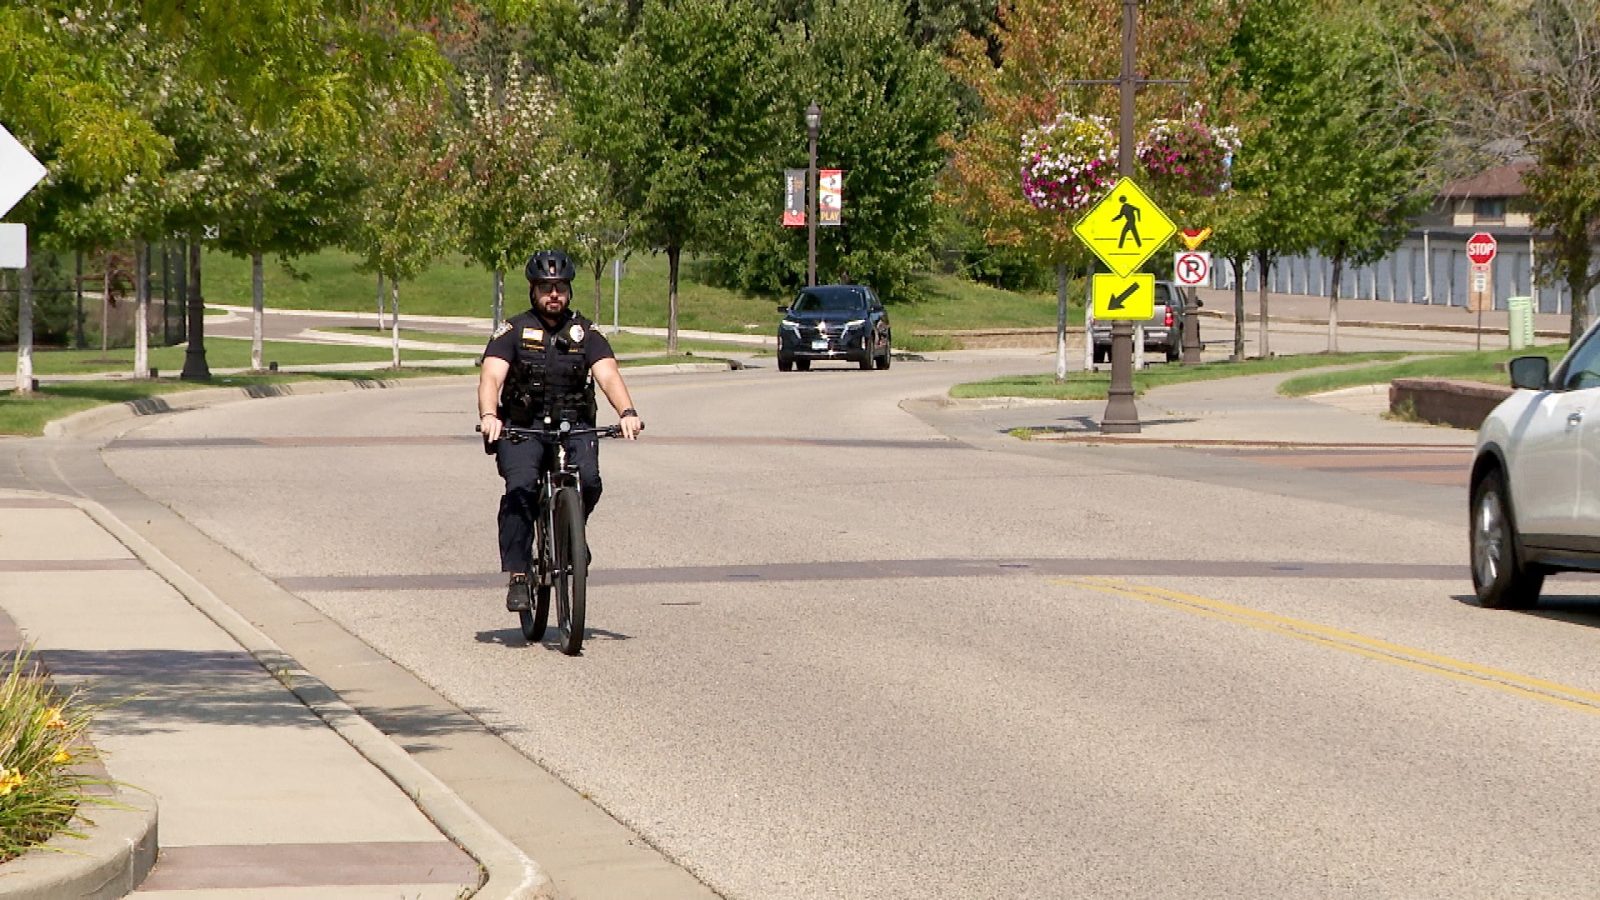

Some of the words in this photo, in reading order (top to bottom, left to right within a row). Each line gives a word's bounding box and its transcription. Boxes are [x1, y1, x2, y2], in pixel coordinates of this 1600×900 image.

[821, 211, 840, 221] PLAY
[1469, 243, 1494, 256] STOP
[1186, 260, 1200, 278] P
